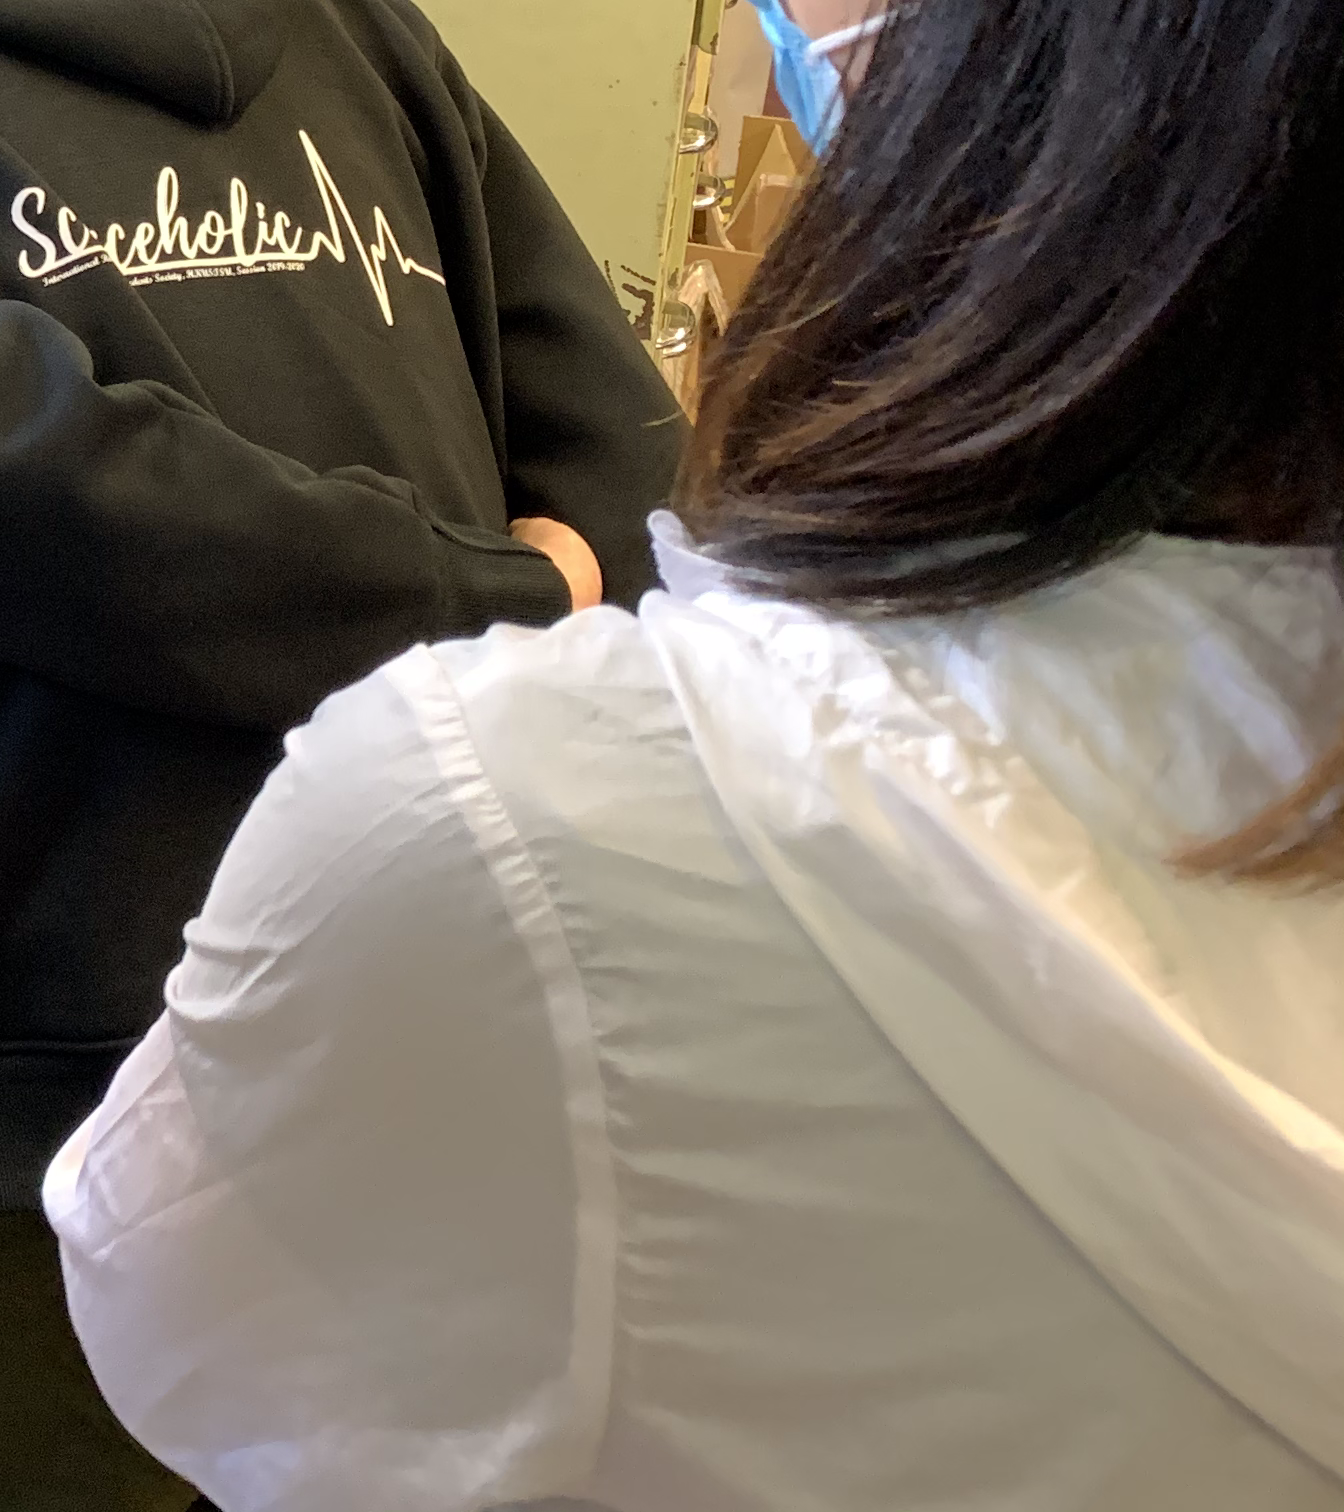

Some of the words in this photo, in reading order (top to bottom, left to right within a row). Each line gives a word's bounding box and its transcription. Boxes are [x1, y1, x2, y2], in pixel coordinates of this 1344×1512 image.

[41, 255, 101, 287] International
[236, 265, 266, 276] Session
[266, 261, 306, 272] 2019-2020
